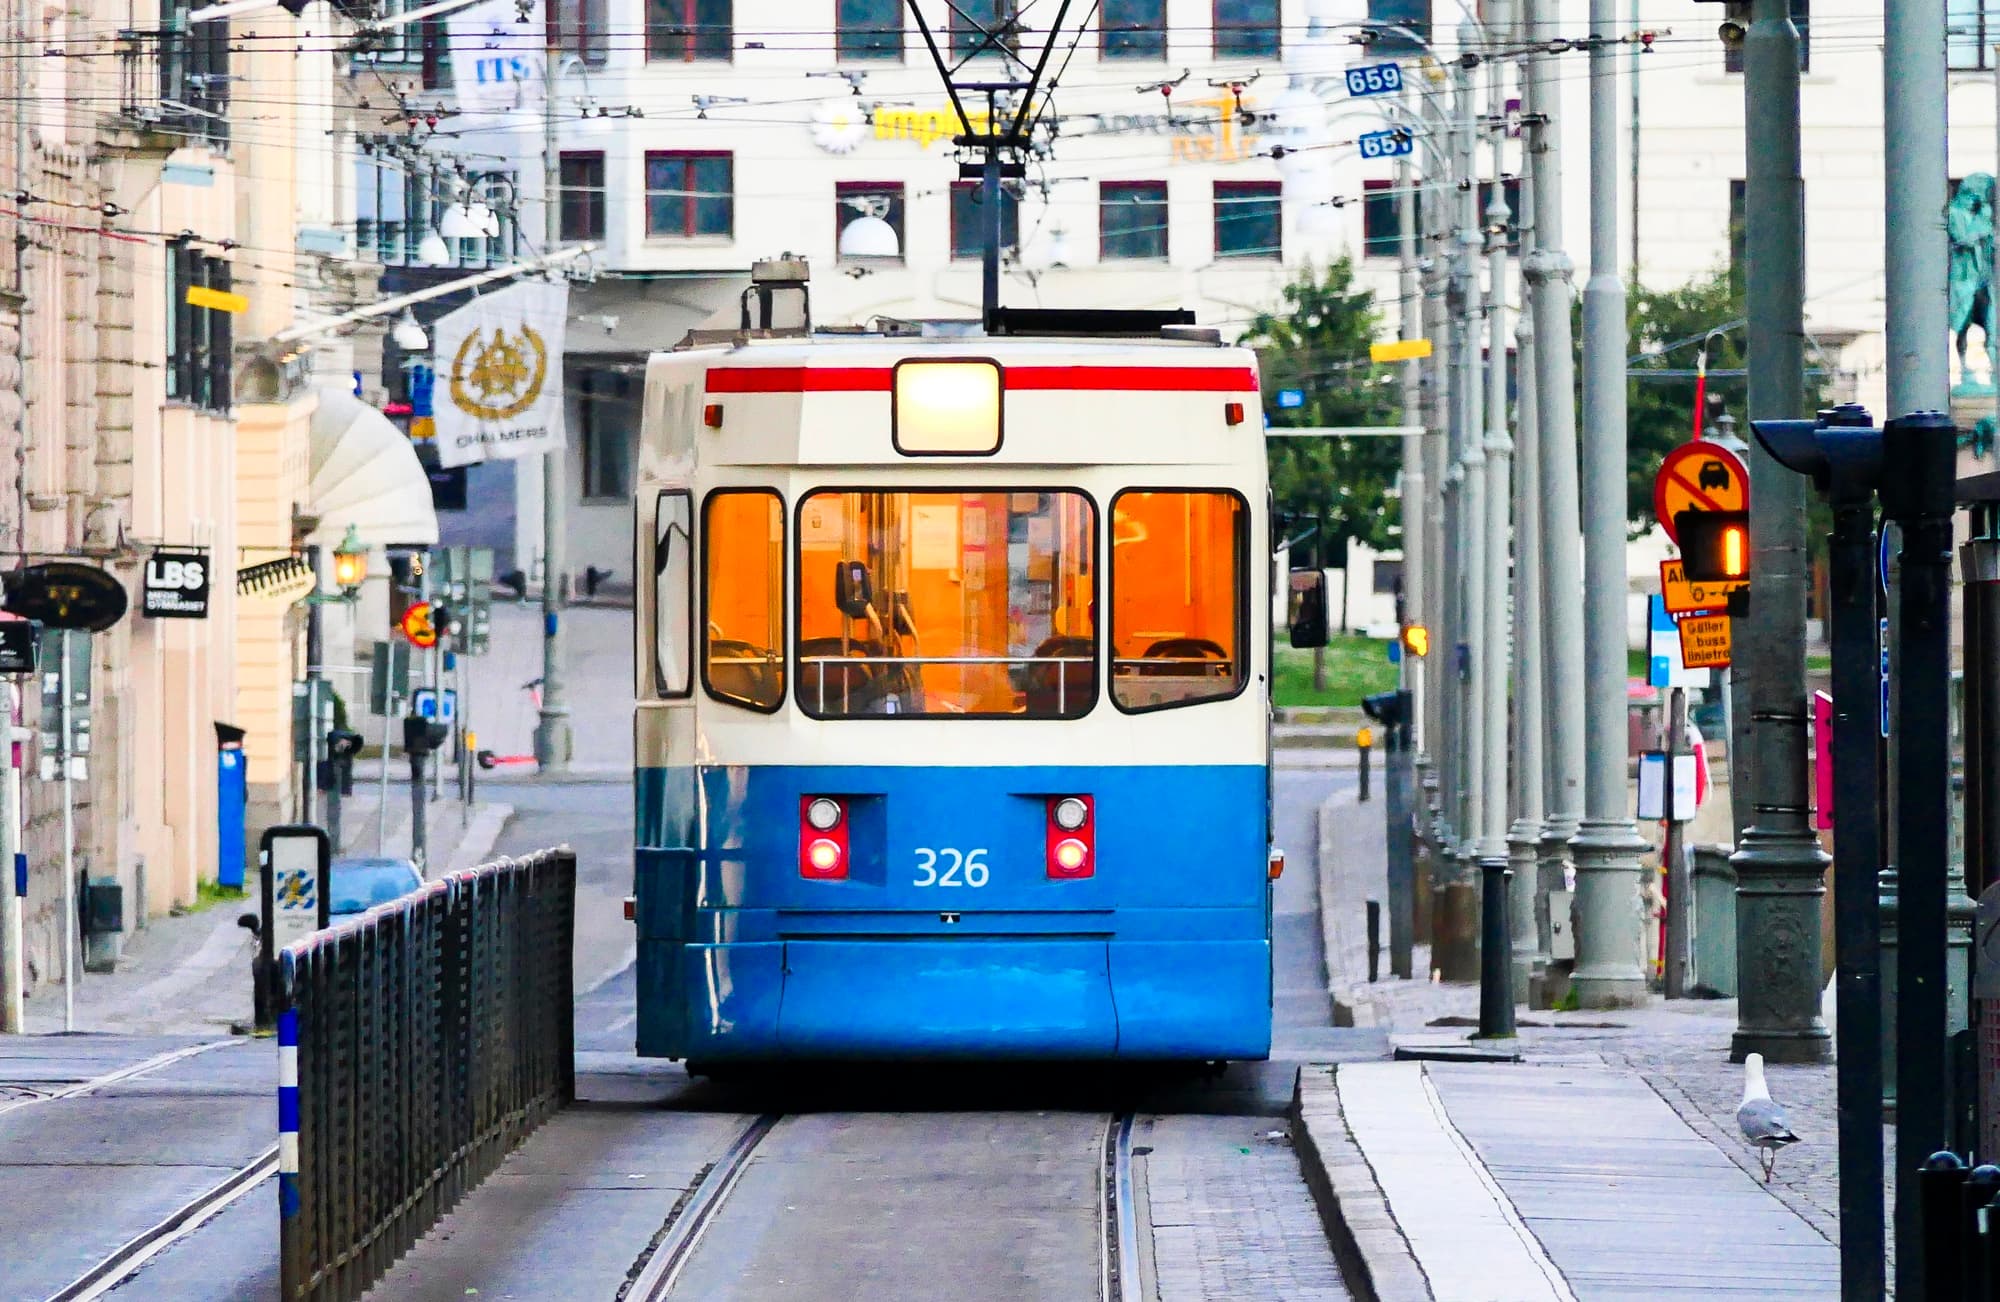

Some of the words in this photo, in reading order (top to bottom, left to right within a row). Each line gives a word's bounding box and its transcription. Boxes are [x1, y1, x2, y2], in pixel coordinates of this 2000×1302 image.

[1348, 67, 1400, 93] 659
[147, 560, 204, 590] LBS
[1696, 635, 1726, 647] buss
[913, 847, 990, 888] 326
